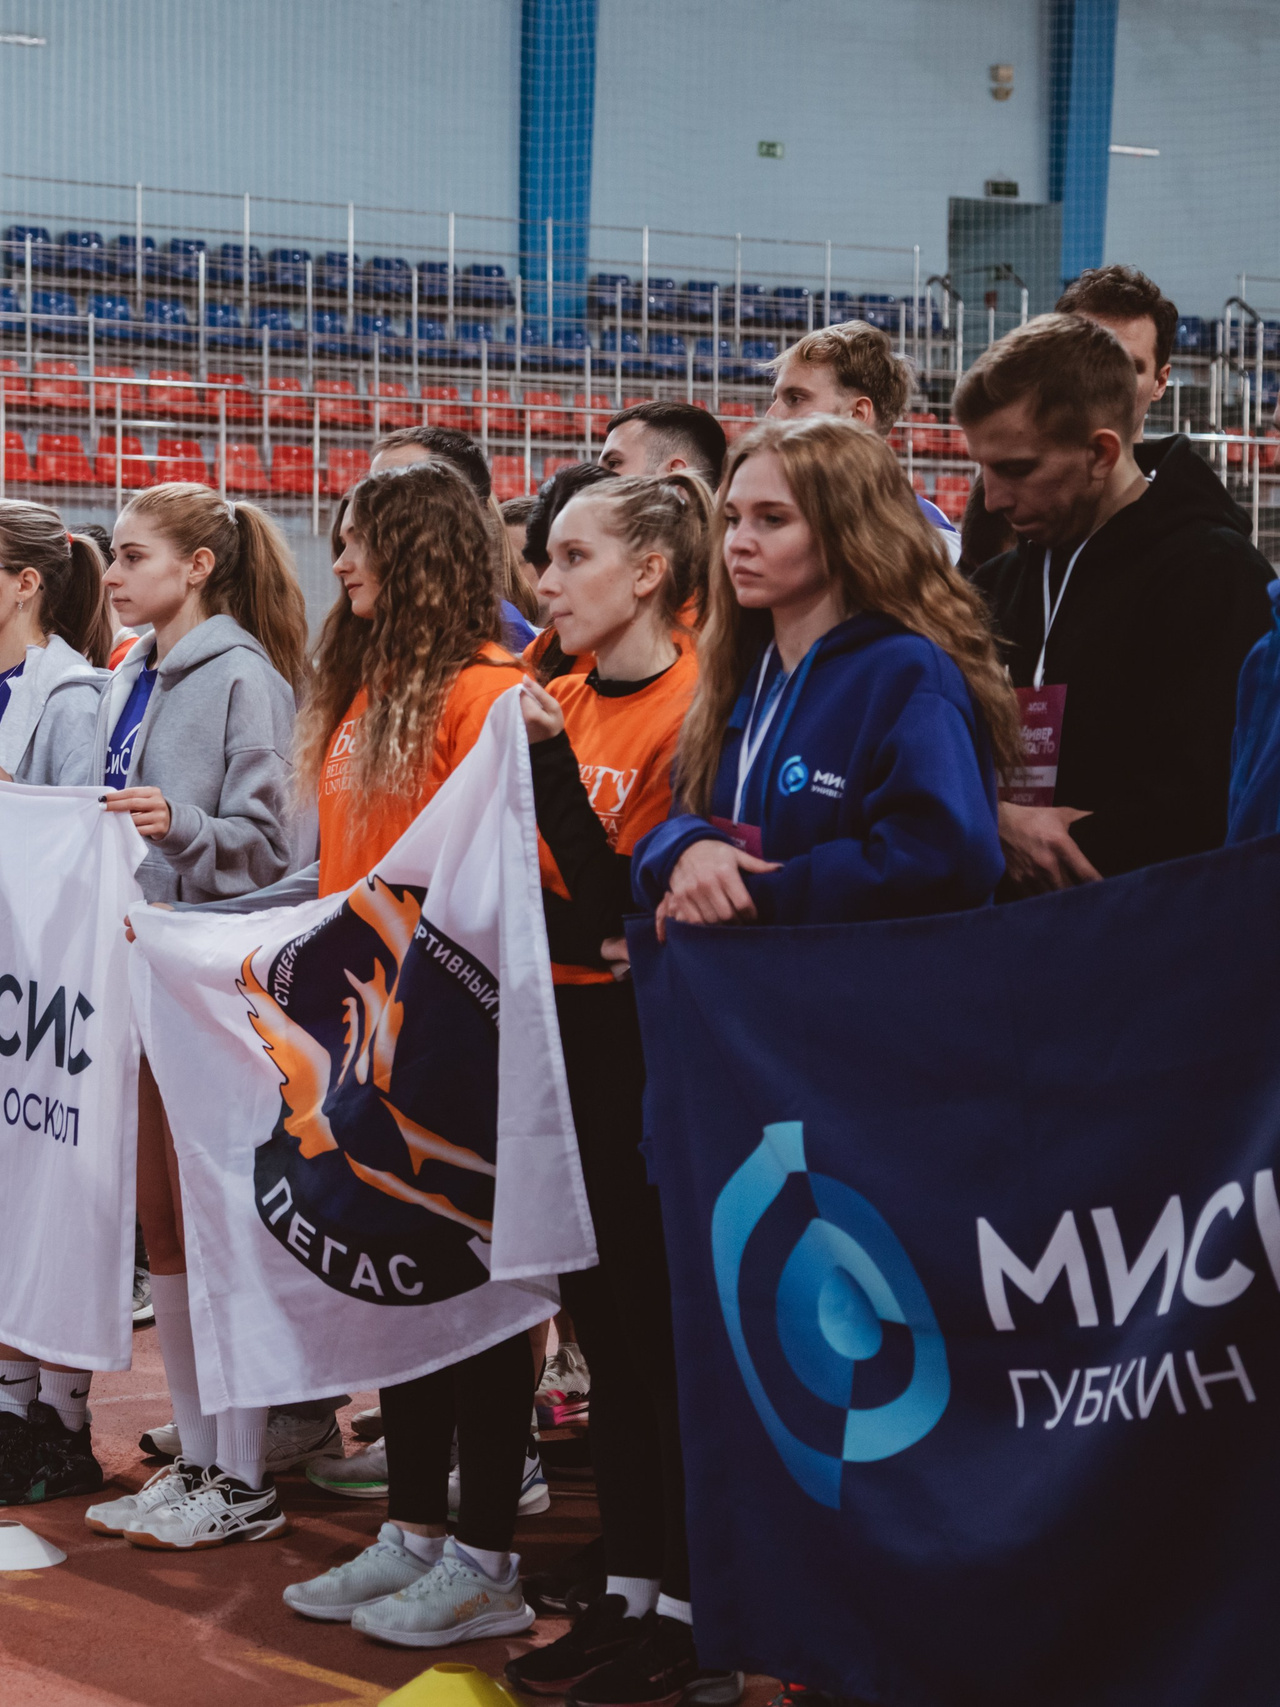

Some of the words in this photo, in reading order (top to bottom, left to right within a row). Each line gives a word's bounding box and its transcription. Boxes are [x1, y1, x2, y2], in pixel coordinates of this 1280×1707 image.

[3, 1087, 80, 1147] ОСКОЛ
[261, 1176, 424, 1297] ПЕГАС
[1008, 1344, 1257, 1430] ГУБКИН
